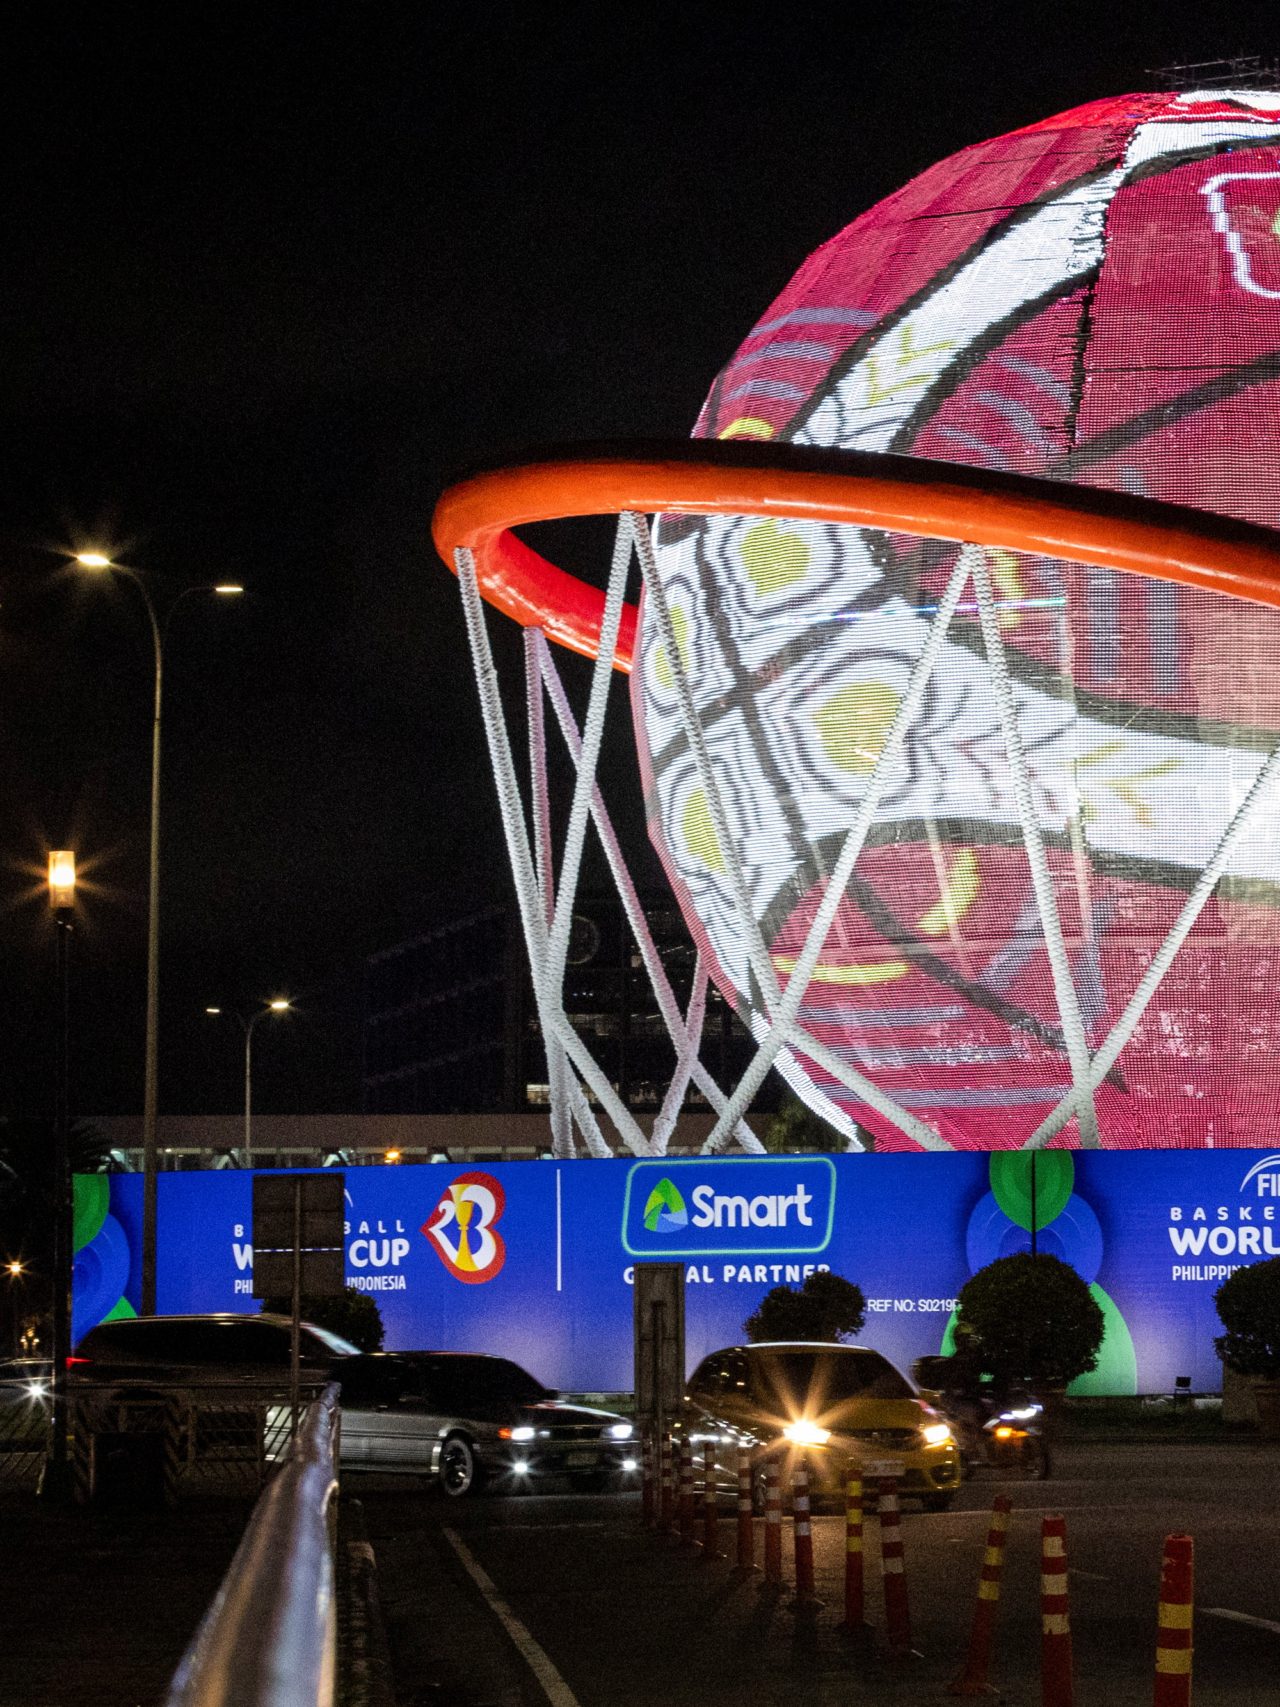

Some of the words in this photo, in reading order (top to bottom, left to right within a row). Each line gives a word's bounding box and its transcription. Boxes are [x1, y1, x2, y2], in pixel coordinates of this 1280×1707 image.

[691, 1184, 813, 1228] Smart
[349, 1238, 410, 1268] CUP
[1172, 1264, 1250, 1281] PHILIPPI
[346, 1275, 406, 1292] INDONESIA
[867, 1299, 893, 1312] REF
[894, 1299, 916, 1312] NO:
